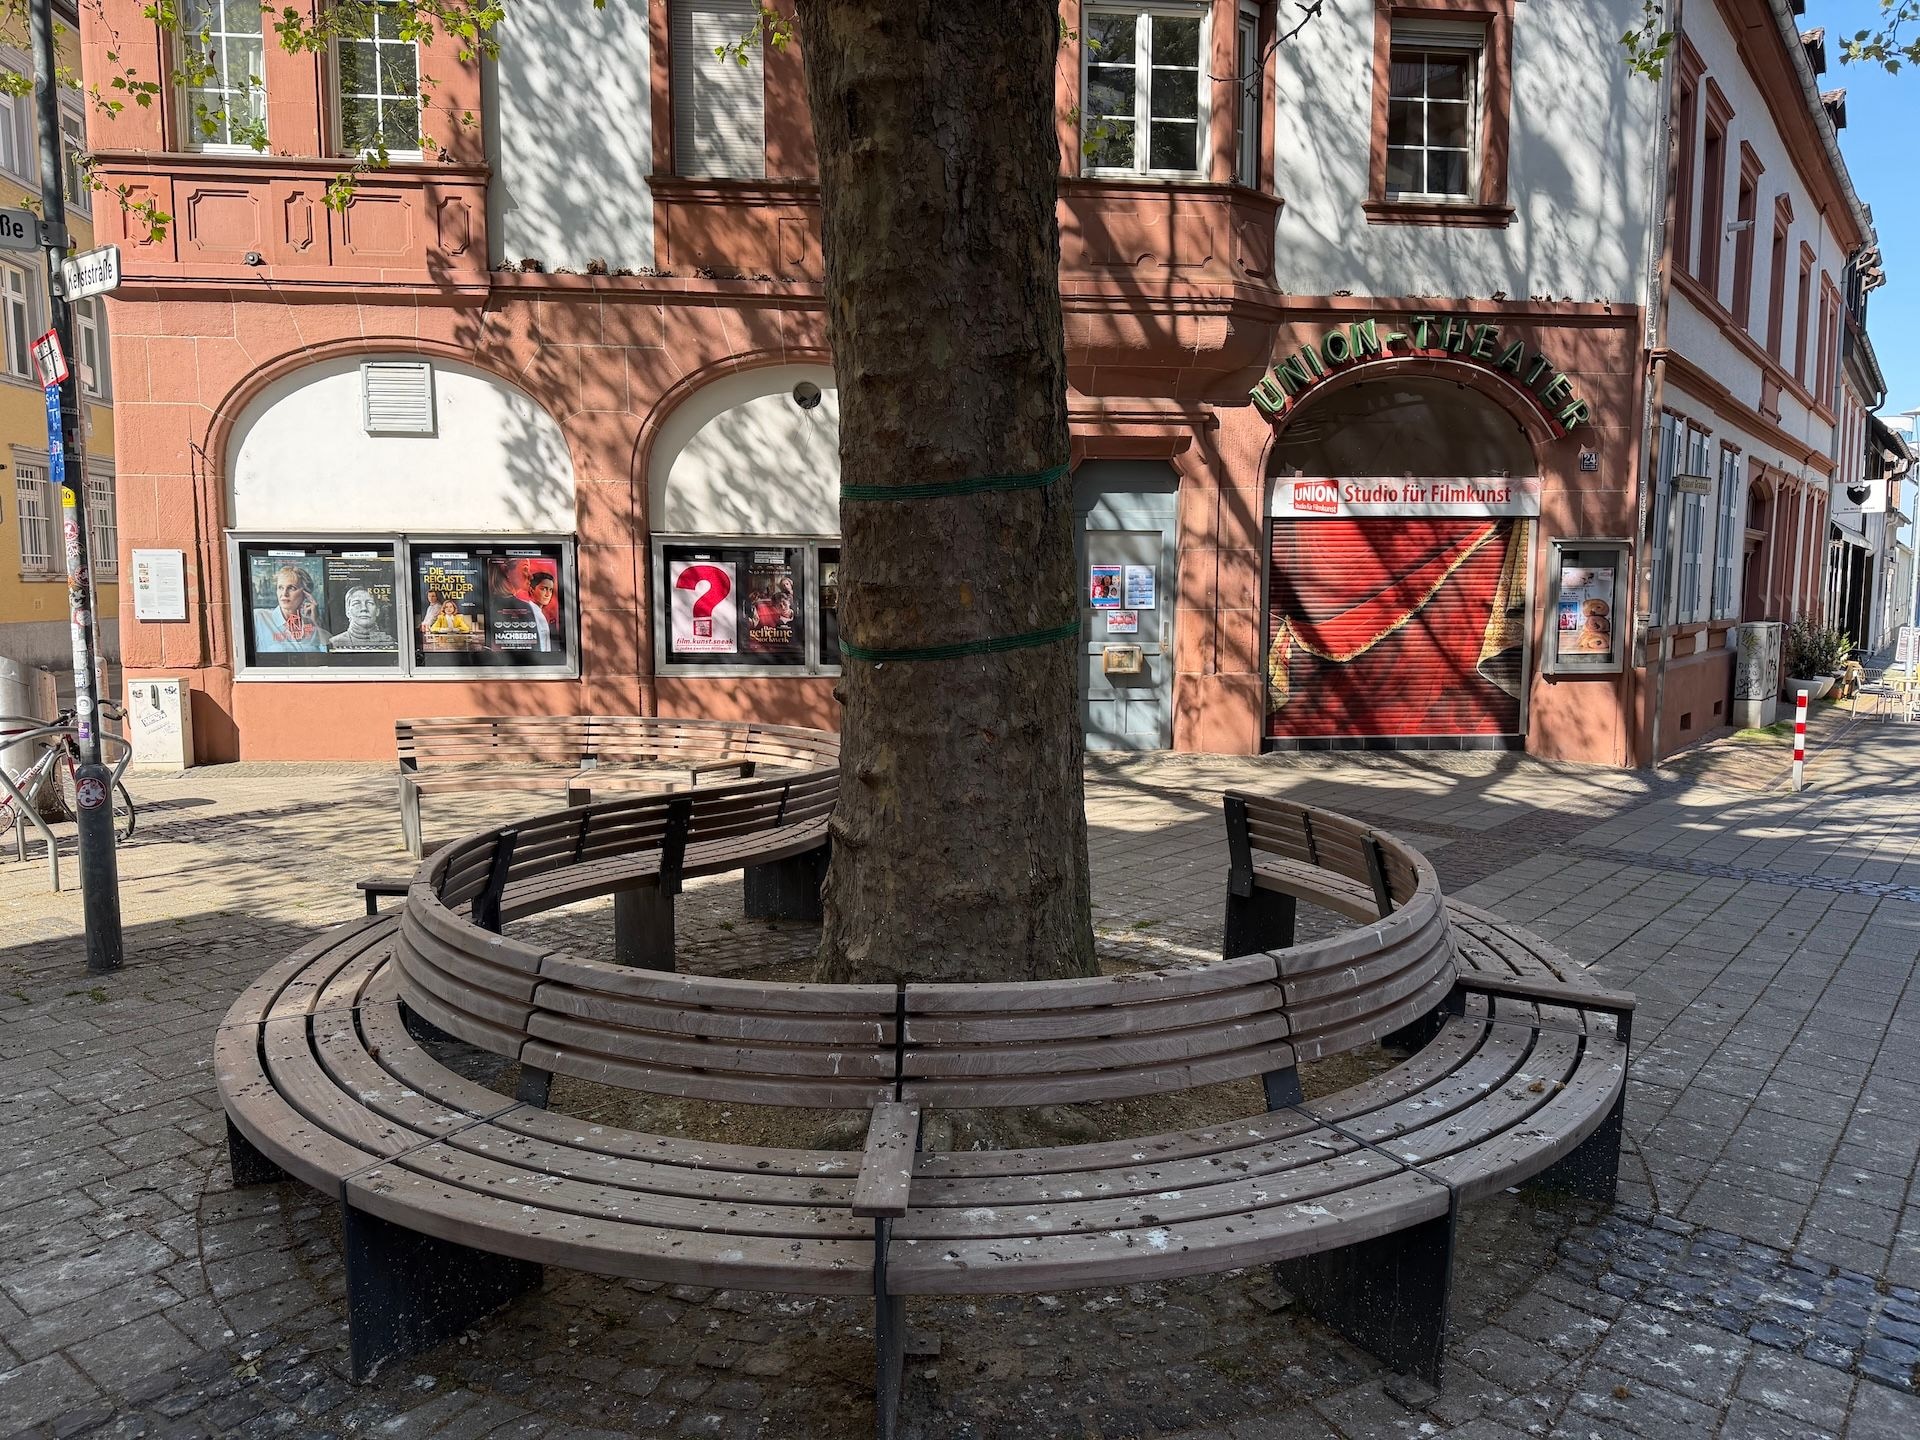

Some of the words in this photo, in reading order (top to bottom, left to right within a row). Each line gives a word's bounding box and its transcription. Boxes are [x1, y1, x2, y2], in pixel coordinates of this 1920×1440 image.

[67, 258, 113, 291] Kerststraße
[1248, 314, 1591, 431] UNION-THEATER
[1584, 454, 1597, 463] 24
[1295, 485, 1338, 502] UNION
[1345, 484, 1398, 503] Studio
[1402, 484, 1427, 502] für
[1431, 484, 1511, 502] Filmkunst
[1313, 504, 1336, 512] Filmkunst
[429, 567, 444, 575] DIE
[423, 575, 465, 583] REICHSTE
[430, 583, 453, 591] FRAU
[442, 591, 466, 599] WELT
[495, 632, 537, 640] NACHBEBEN
